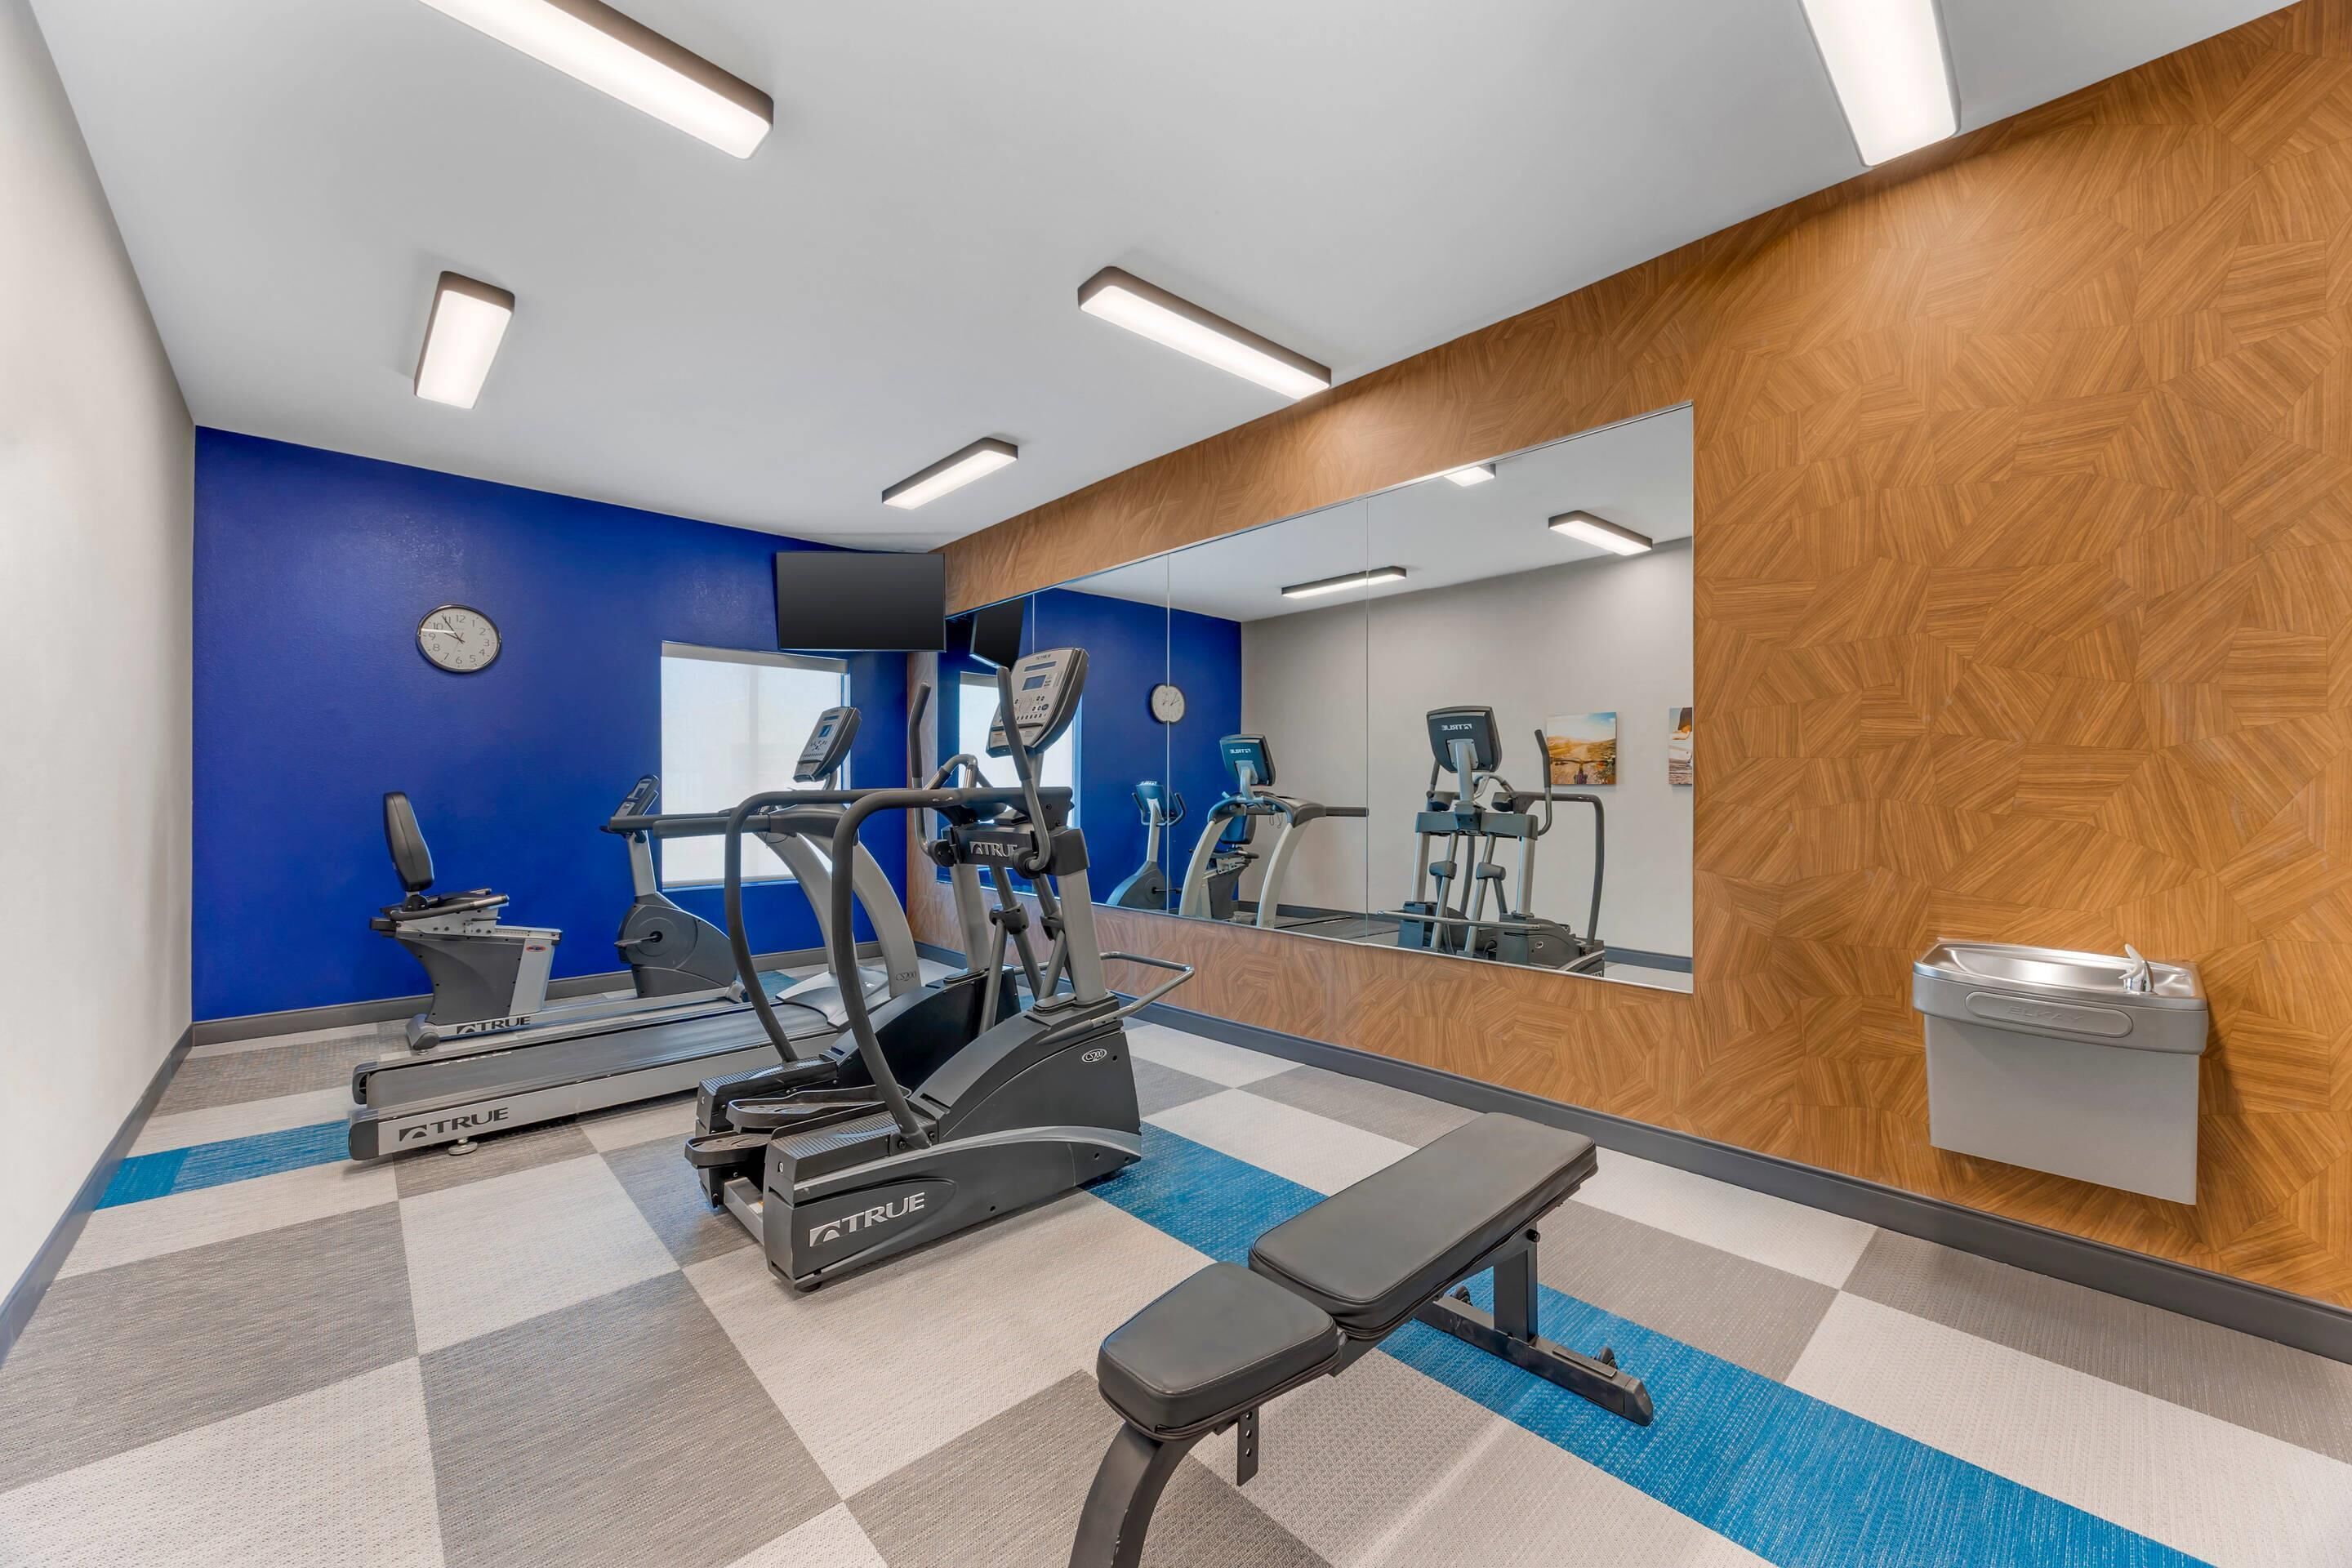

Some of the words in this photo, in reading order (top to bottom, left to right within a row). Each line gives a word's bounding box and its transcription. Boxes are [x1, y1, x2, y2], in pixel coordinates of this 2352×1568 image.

[456, 614, 466, 623] 12
[433, 622, 443, 630] 10
[471, 619, 475, 628] 1
[479, 627, 487, 635] 2
[483, 639, 490, 647] 3
[433, 644, 440, 652] 8
[455, 656, 463, 665] 6
[470, 654, 476, 663] 5
[2007, 1005, 2085, 1022] ELKAY
[476, 1016, 532, 1031] TRUE
[430, 1107, 509, 1134] TRUE
[841, 1192, 925, 1233] TRUE
